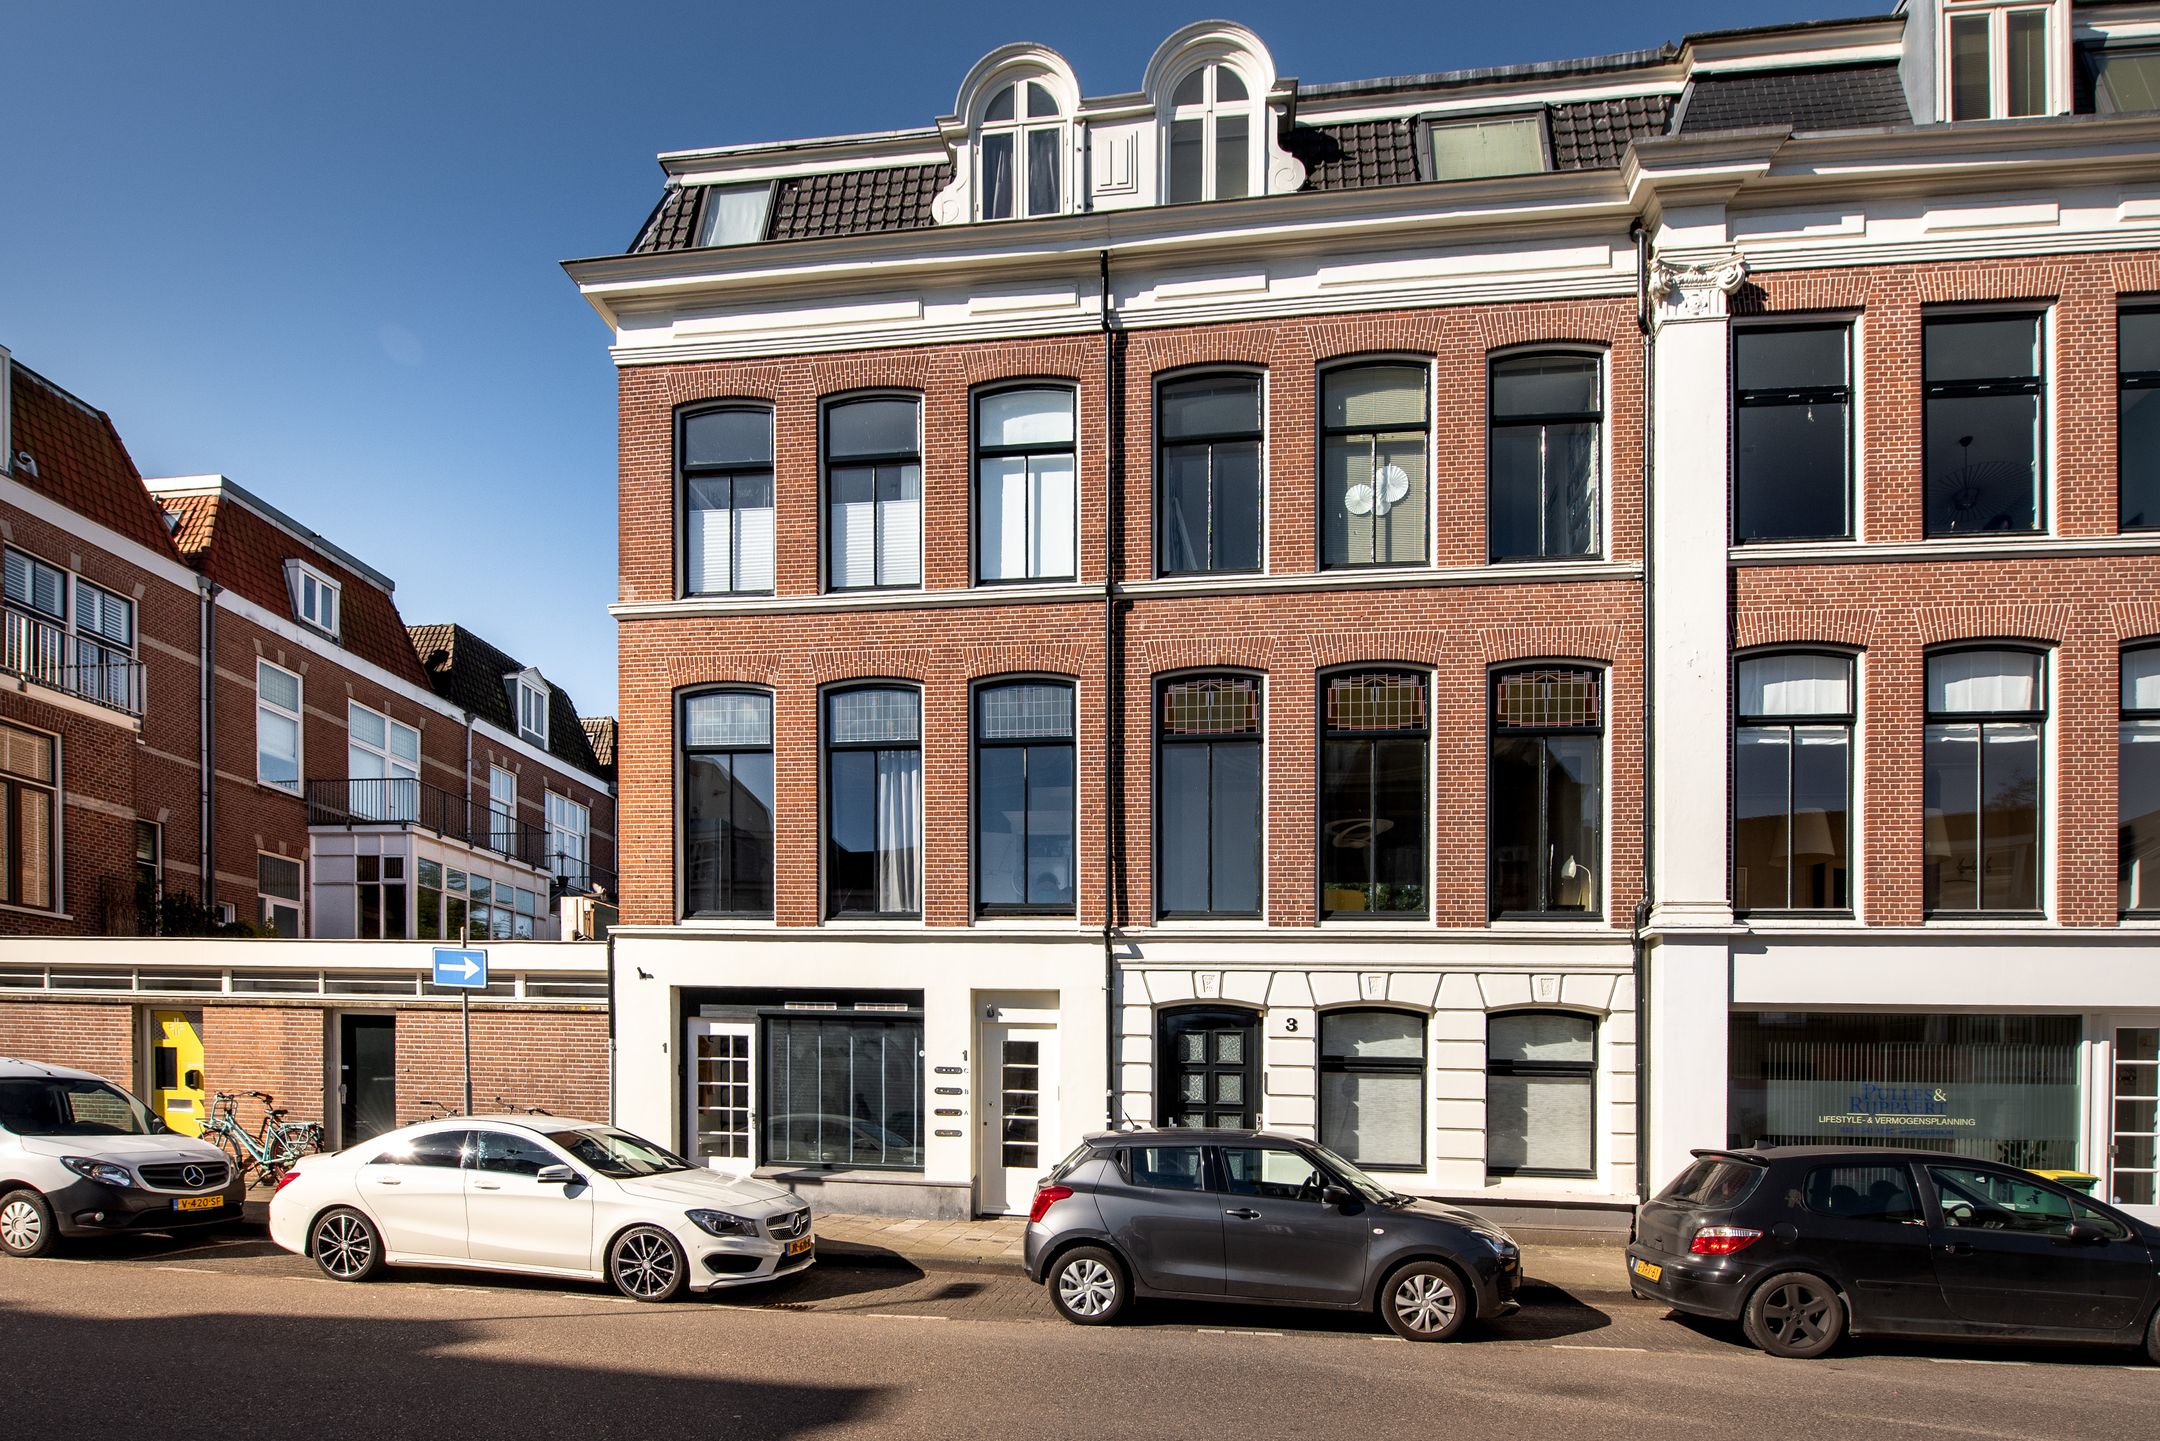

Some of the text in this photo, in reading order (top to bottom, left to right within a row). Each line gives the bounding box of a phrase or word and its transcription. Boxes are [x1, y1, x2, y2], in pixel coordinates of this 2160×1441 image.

[1285, 1017, 1299, 1033] 3
[662, 1042, 668, 1054] 1
[962, 1050, 968, 1061] 1
[1818, 1115, 1866, 1124] LIFESTYLE-
[1874, 1116, 1976, 1126] VERMOGENSPLANNING
